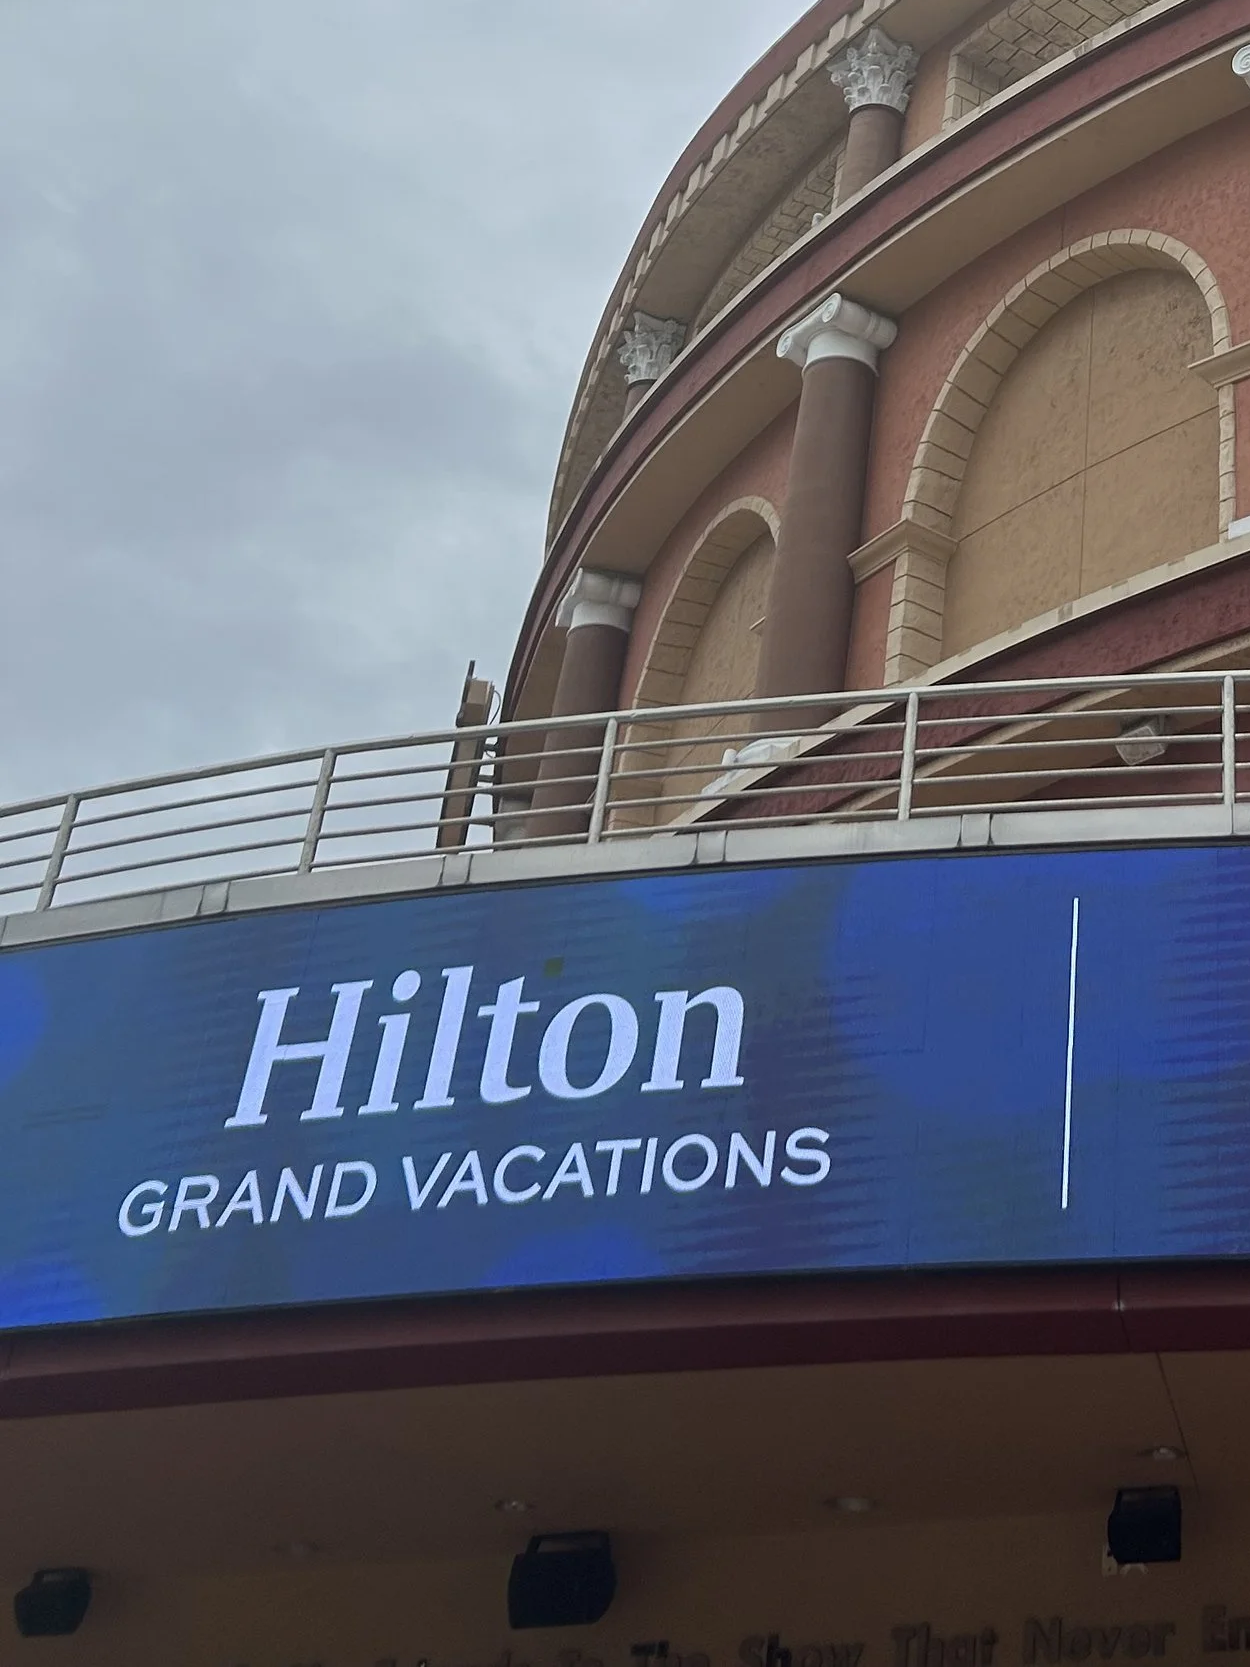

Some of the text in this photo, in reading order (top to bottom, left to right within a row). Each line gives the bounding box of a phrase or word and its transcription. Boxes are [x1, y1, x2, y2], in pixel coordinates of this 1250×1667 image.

[223, 965, 745, 1129] Hilton
[118, 1127, 831, 1236] GRAND VACATIONS
[891, 1621, 999, 1667] That
[1022, 1616, 1177, 1665] Never
